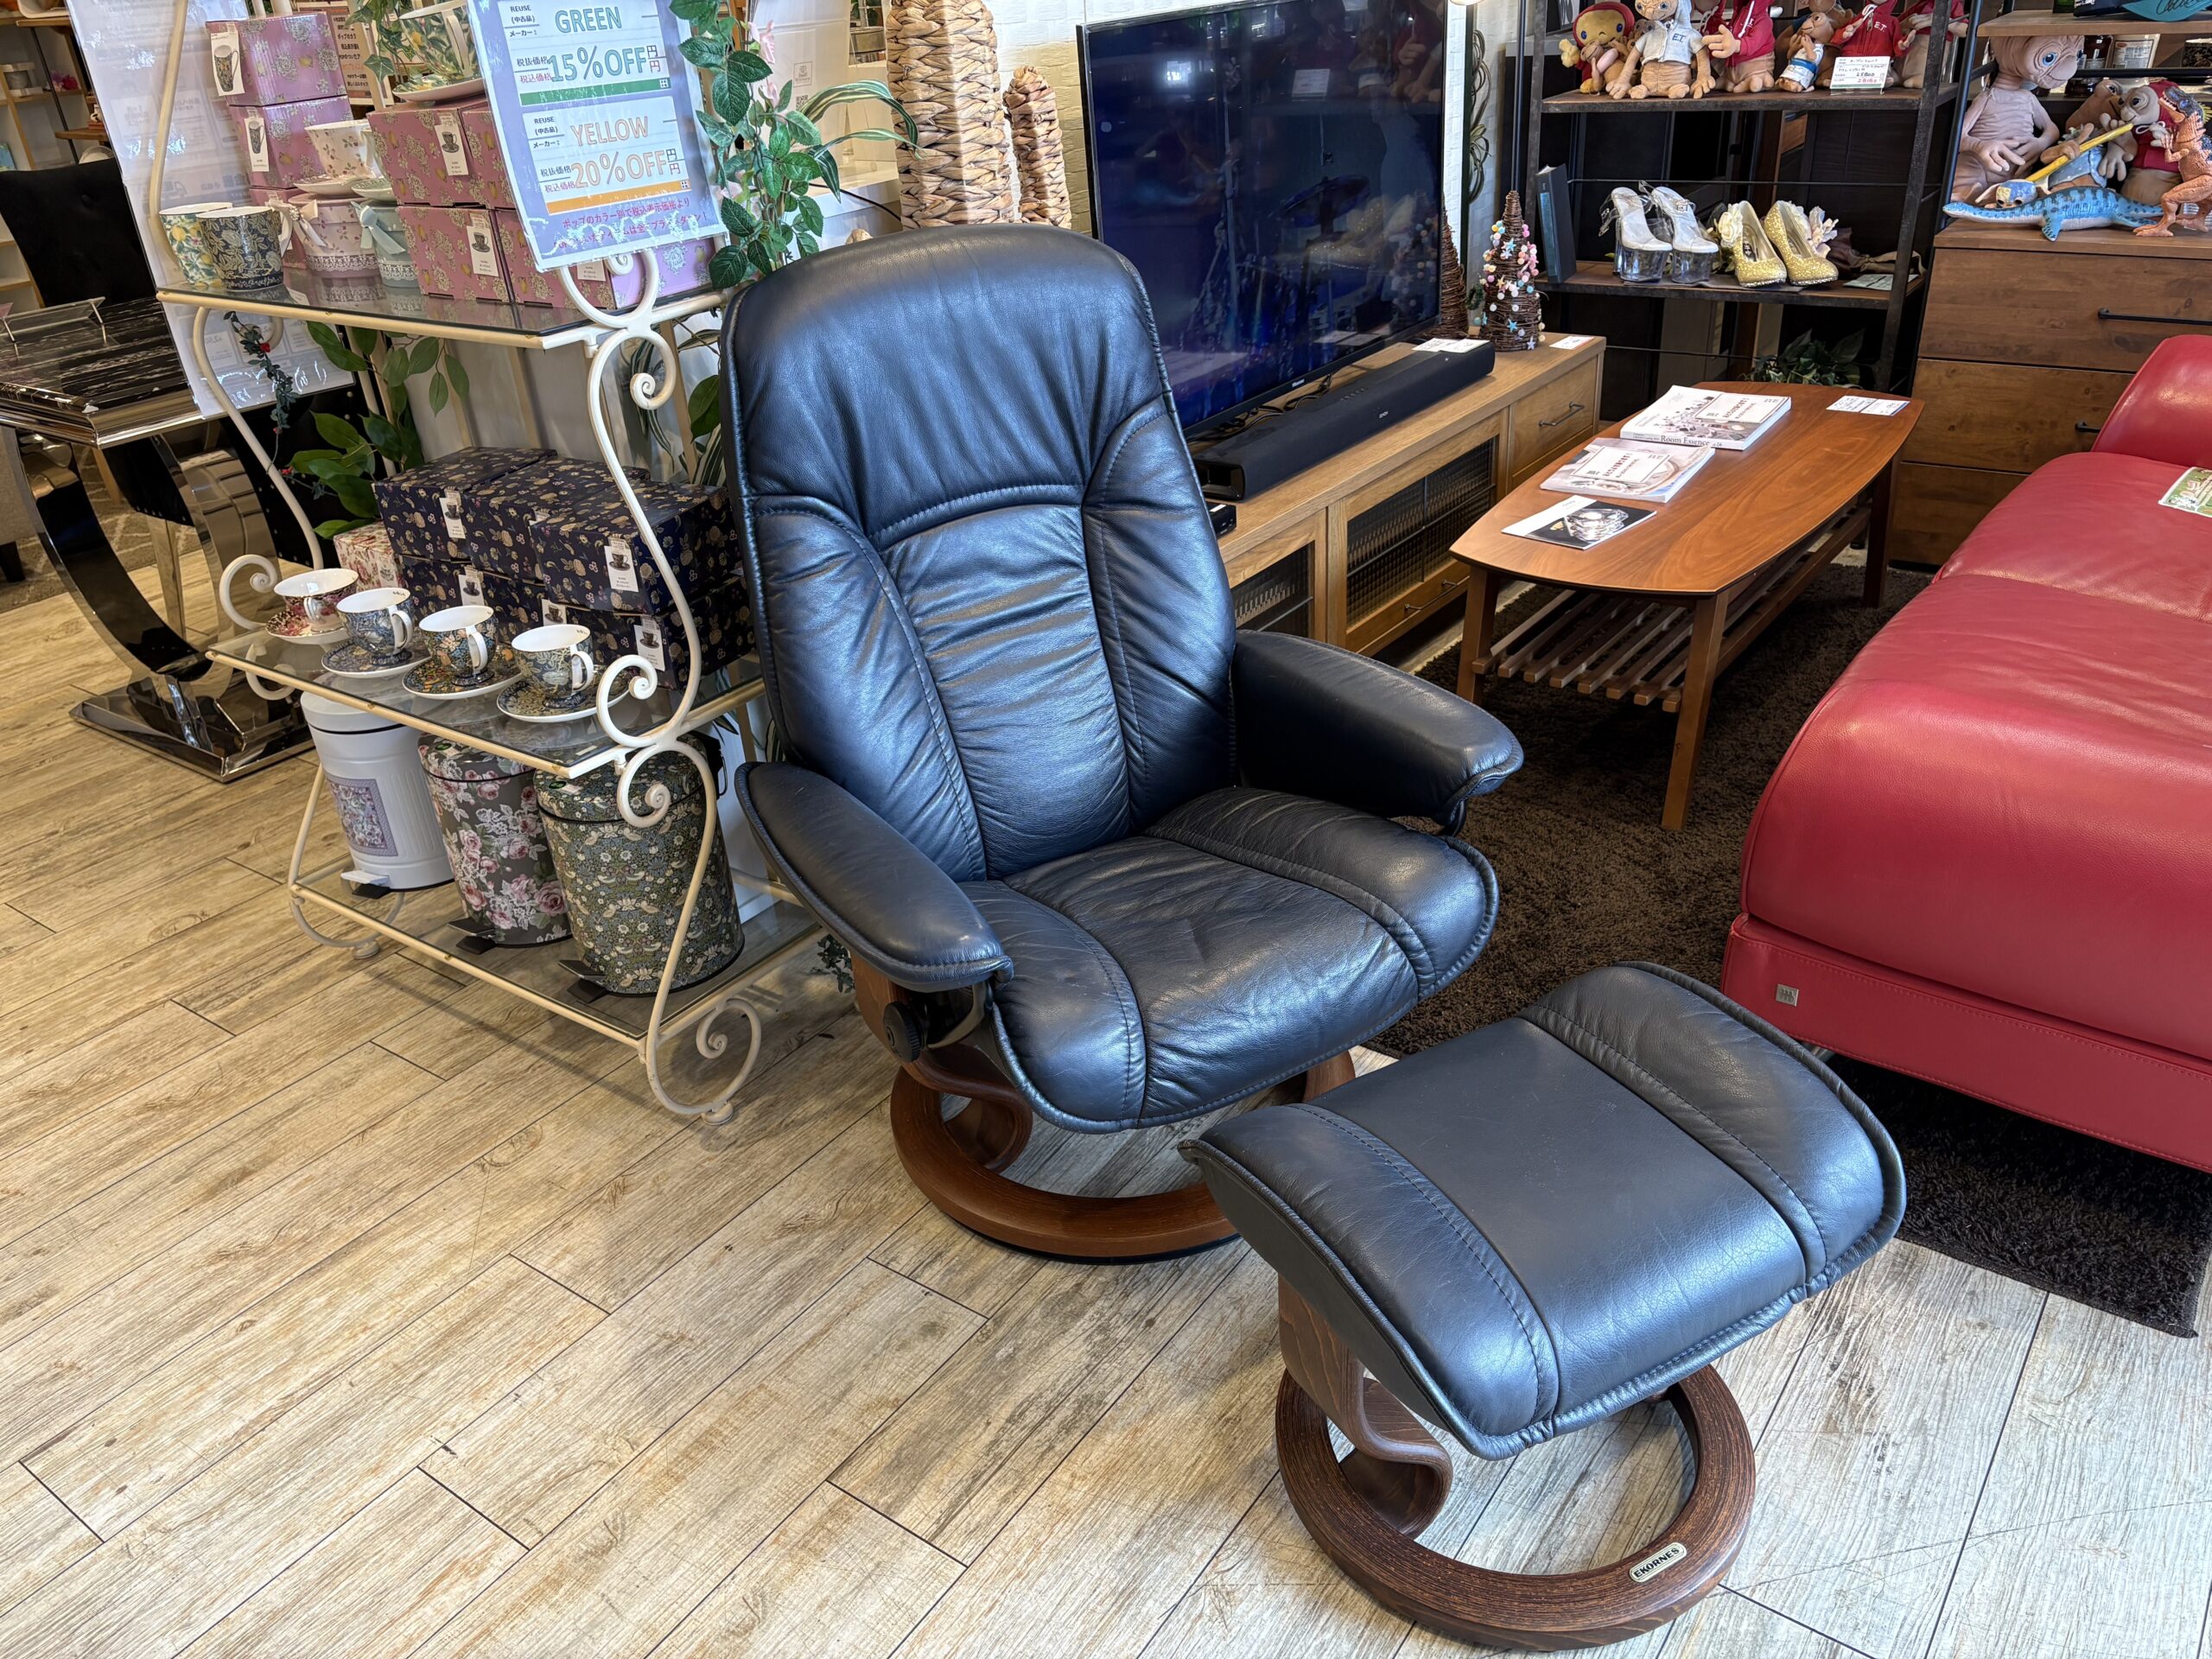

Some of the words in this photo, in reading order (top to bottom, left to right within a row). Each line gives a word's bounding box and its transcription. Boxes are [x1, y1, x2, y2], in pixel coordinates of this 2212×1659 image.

[511, 15, 536, 24] (中古品)
[555, 6, 622, 33] GREEN
[646, 45, 658, 58] 円
[517, 55, 549, 67] 税抜価格
[548, 46, 647, 82] 15%OFF
[649, 60, 661, 73] 円
[519, 72, 553, 84] 税込価格
[535, 126, 558, 136] (中古品)
[570, 116, 648, 146] YELLOW
[666, 149, 677, 162] 円
[540, 165, 572, 177] 税抜価格
[570, 151, 667, 188] 20%OFF
[669, 162, 681, 175] 円
[544, 181, 576, 193] 税込価格
[1661, 435, 1681, 443] Room
[1683, 436, 1710, 447] Essence
[1633, 1548, 1680, 1578] EKORNES
